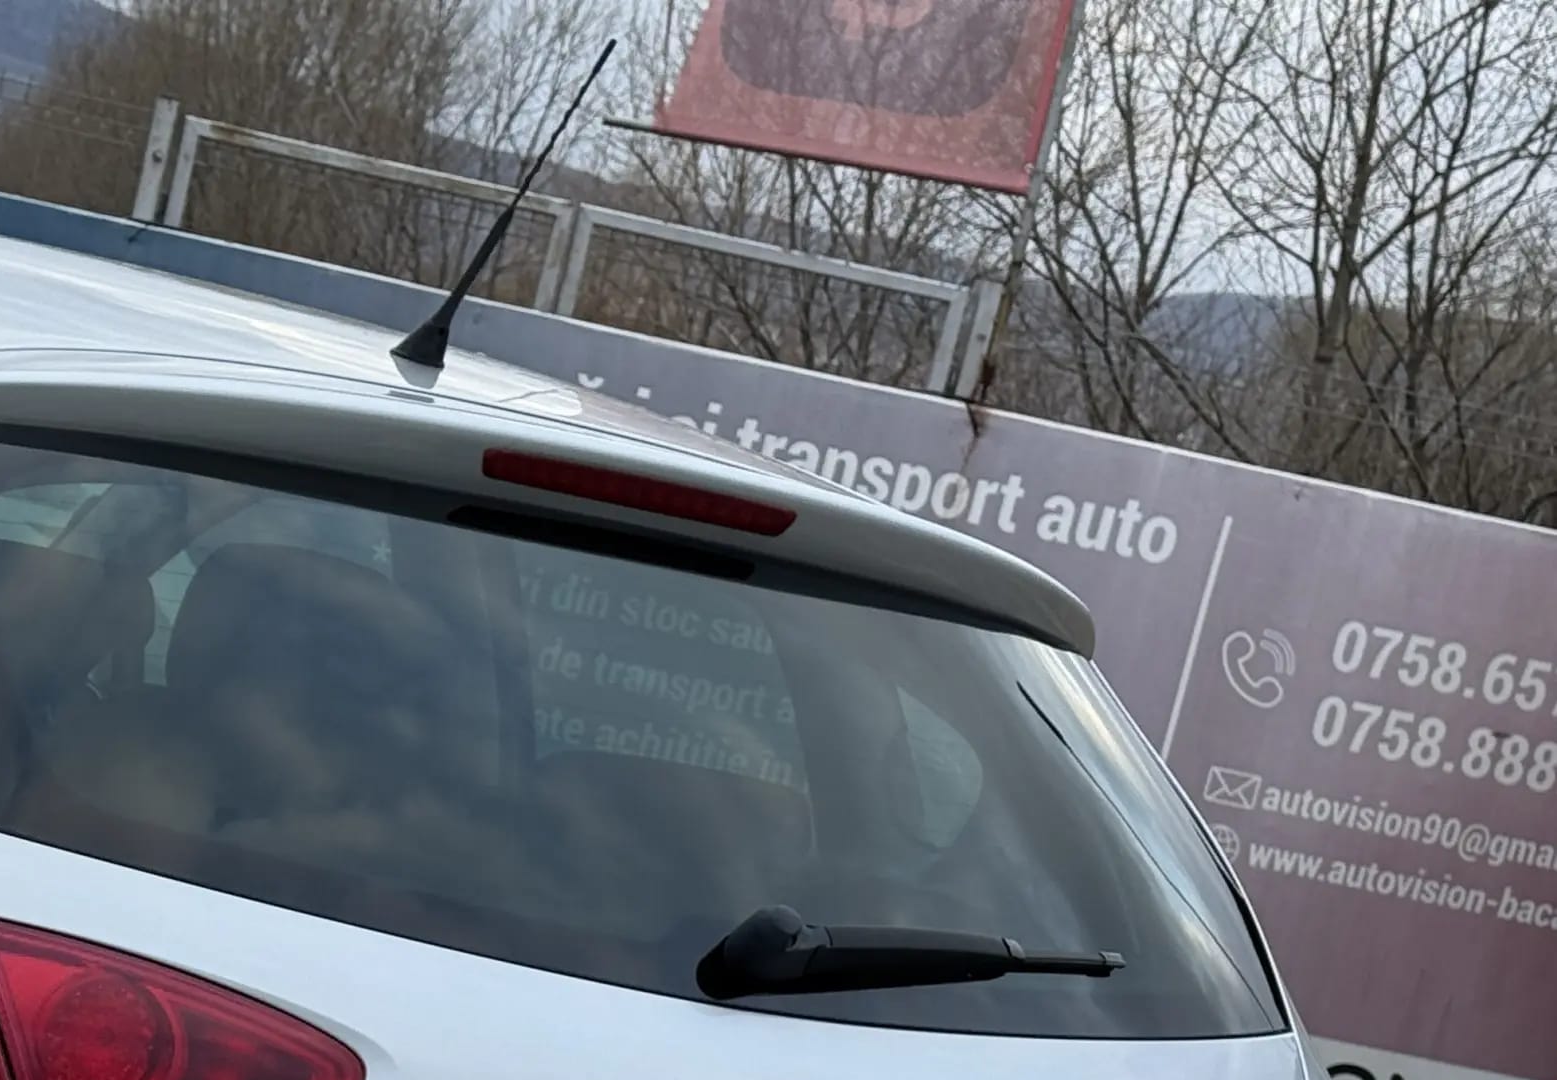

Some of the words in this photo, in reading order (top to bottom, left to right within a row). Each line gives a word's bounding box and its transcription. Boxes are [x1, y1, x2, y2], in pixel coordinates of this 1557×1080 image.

[736, 418, 1026, 534] transport
[1036, 494, 1178, 564] auto
[551, 573, 610, 619] din
[538, 637, 582, 680] de
[593, 652, 768, 720] transport
[1332, 620, 1557, 717] 0758.65
